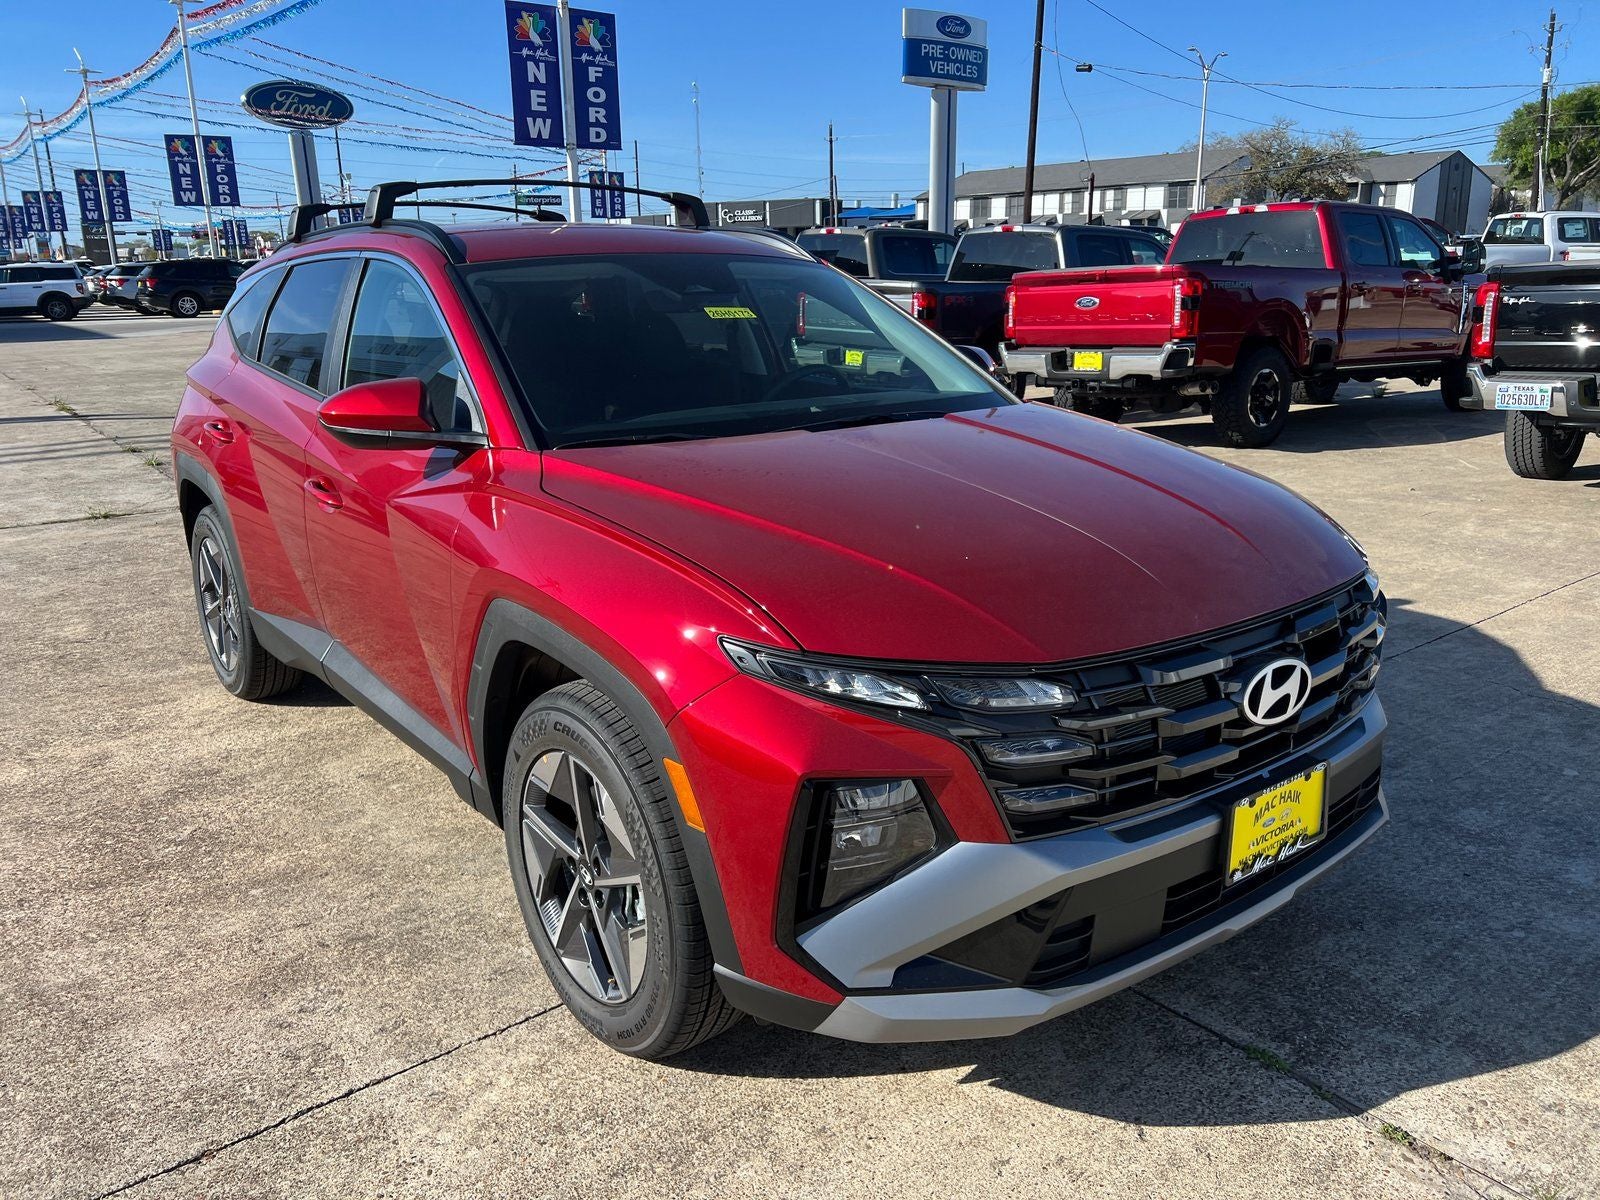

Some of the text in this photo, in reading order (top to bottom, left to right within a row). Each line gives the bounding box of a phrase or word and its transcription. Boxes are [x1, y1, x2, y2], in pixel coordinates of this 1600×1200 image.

[946, 19, 965, 34] Ford
[930, 61, 978, 78] VEHICLES
[271, 89, 333, 118] Ford
[527, 61, 552, 139] NEW
[586, 66, 608, 143] FORD
[178, 163, 196, 203] NEW
[216, 164, 231, 204] FORD
[84, 190, 98, 220] NEW
[113, 190, 125, 220] FORD
[595, 190, 604, 216] NEW
[614, 191, 622, 217] FORD
[30, 206, 42, 230] NEW
[53, 206, 63, 231] FORD
[1211, 281, 1252, 289] TREMOR
[709, 308, 753, 318] 26H0173
[1501, 393, 1546, 406] 02563DLR
[1253, 794, 1278, 828] MAC
[1279, 789, 1302, 806] HAIK
[1255, 820, 1295, 846] VICTORIA
[1278, 836, 1318, 861] Haik
